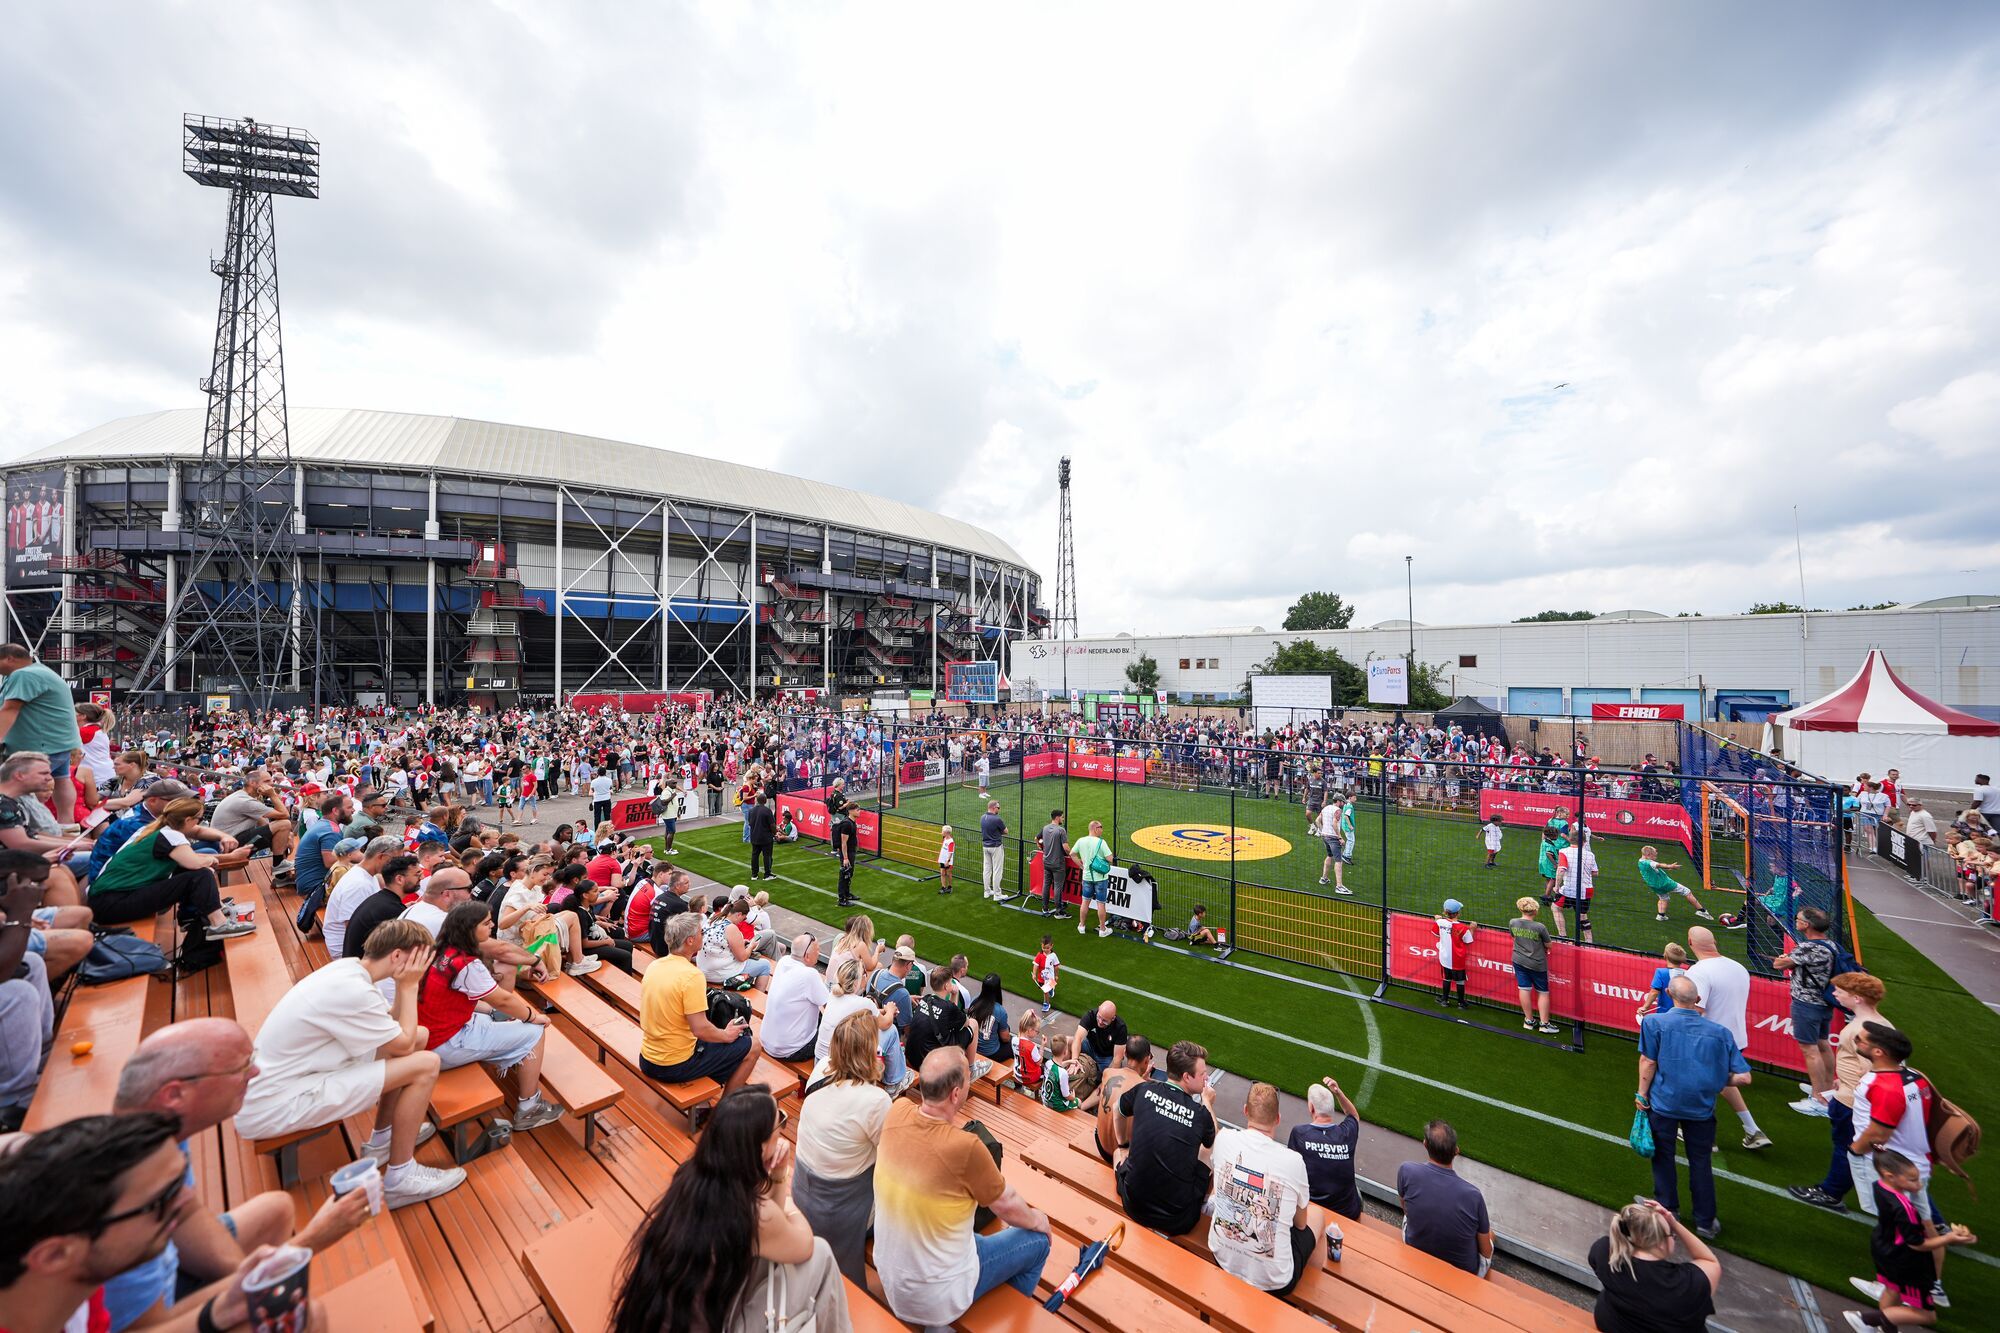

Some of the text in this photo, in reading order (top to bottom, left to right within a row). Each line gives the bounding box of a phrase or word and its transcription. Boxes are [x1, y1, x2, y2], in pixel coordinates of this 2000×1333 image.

[1618, 706, 1660, 719] EHBO
[1151, 841, 1232, 857] FOUNDATION
[1144, 1090, 1195, 1120] PRIJSVRIJ
[1155, 1105, 1193, 1128] vakanties
[1304, 1141, 1349, 1154] PRIJSVRIJ
[1318, 1152, 1350, 1161] vakanties
